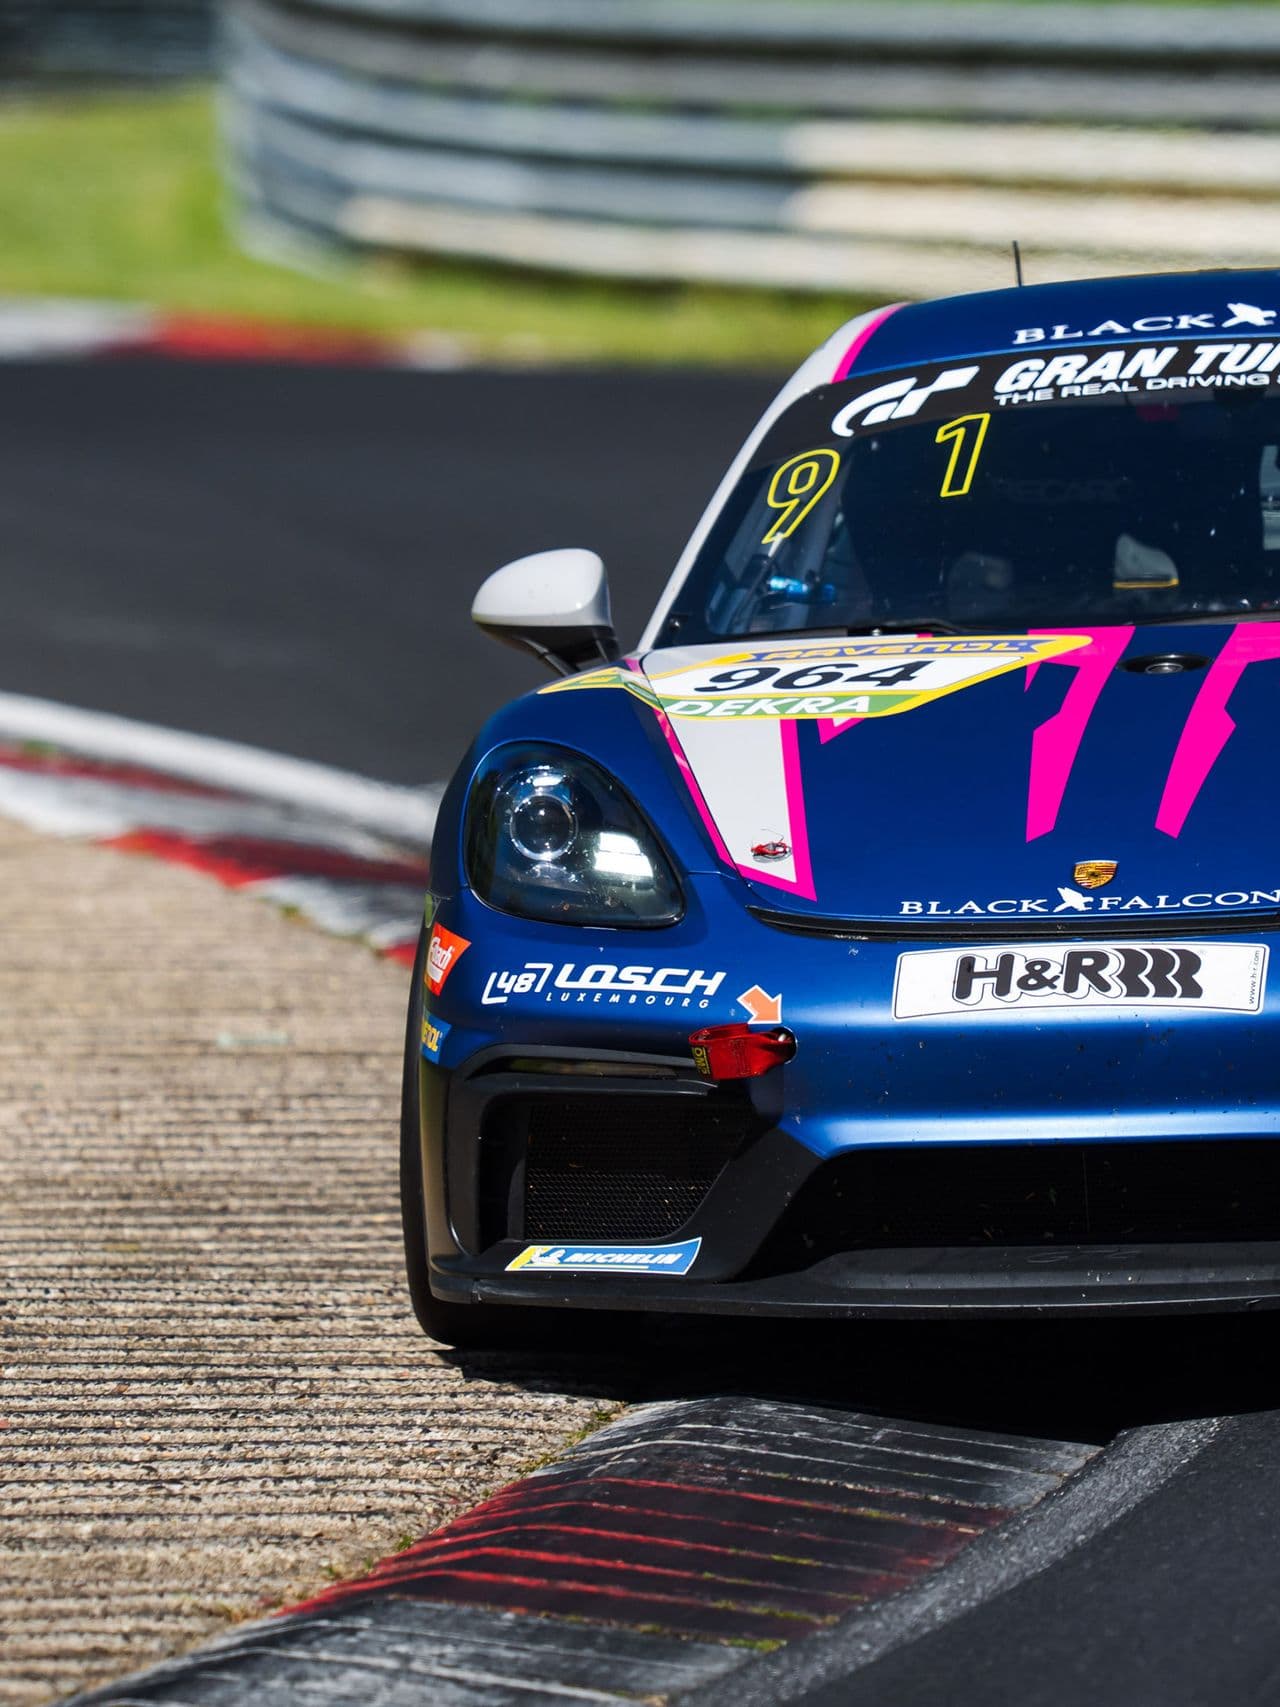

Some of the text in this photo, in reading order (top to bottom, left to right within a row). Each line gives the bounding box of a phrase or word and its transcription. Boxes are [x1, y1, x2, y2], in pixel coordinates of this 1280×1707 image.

[1011, 313, 1216, 345] BLACK
[994, 346, 1179, 394] GRAN
[993, 387, 1054, 406] THE
[1060, 380, 1139, 399] REAL
[1146, 373, 1270, 390] DRIVING
[934, 413, 990, 497] 1
[761, 448, 841, 544] 9
[694, 660, 936, 692] 964
[663, 695, 871, 717] DEKRA
[900, 897, 1048, 915] BLACK
[554, 963, 727, 996] LOSCH
[545, 991, 709, 1009] LUXEMBOURG
[562, 1252, 684, 1265] MICHELIN
